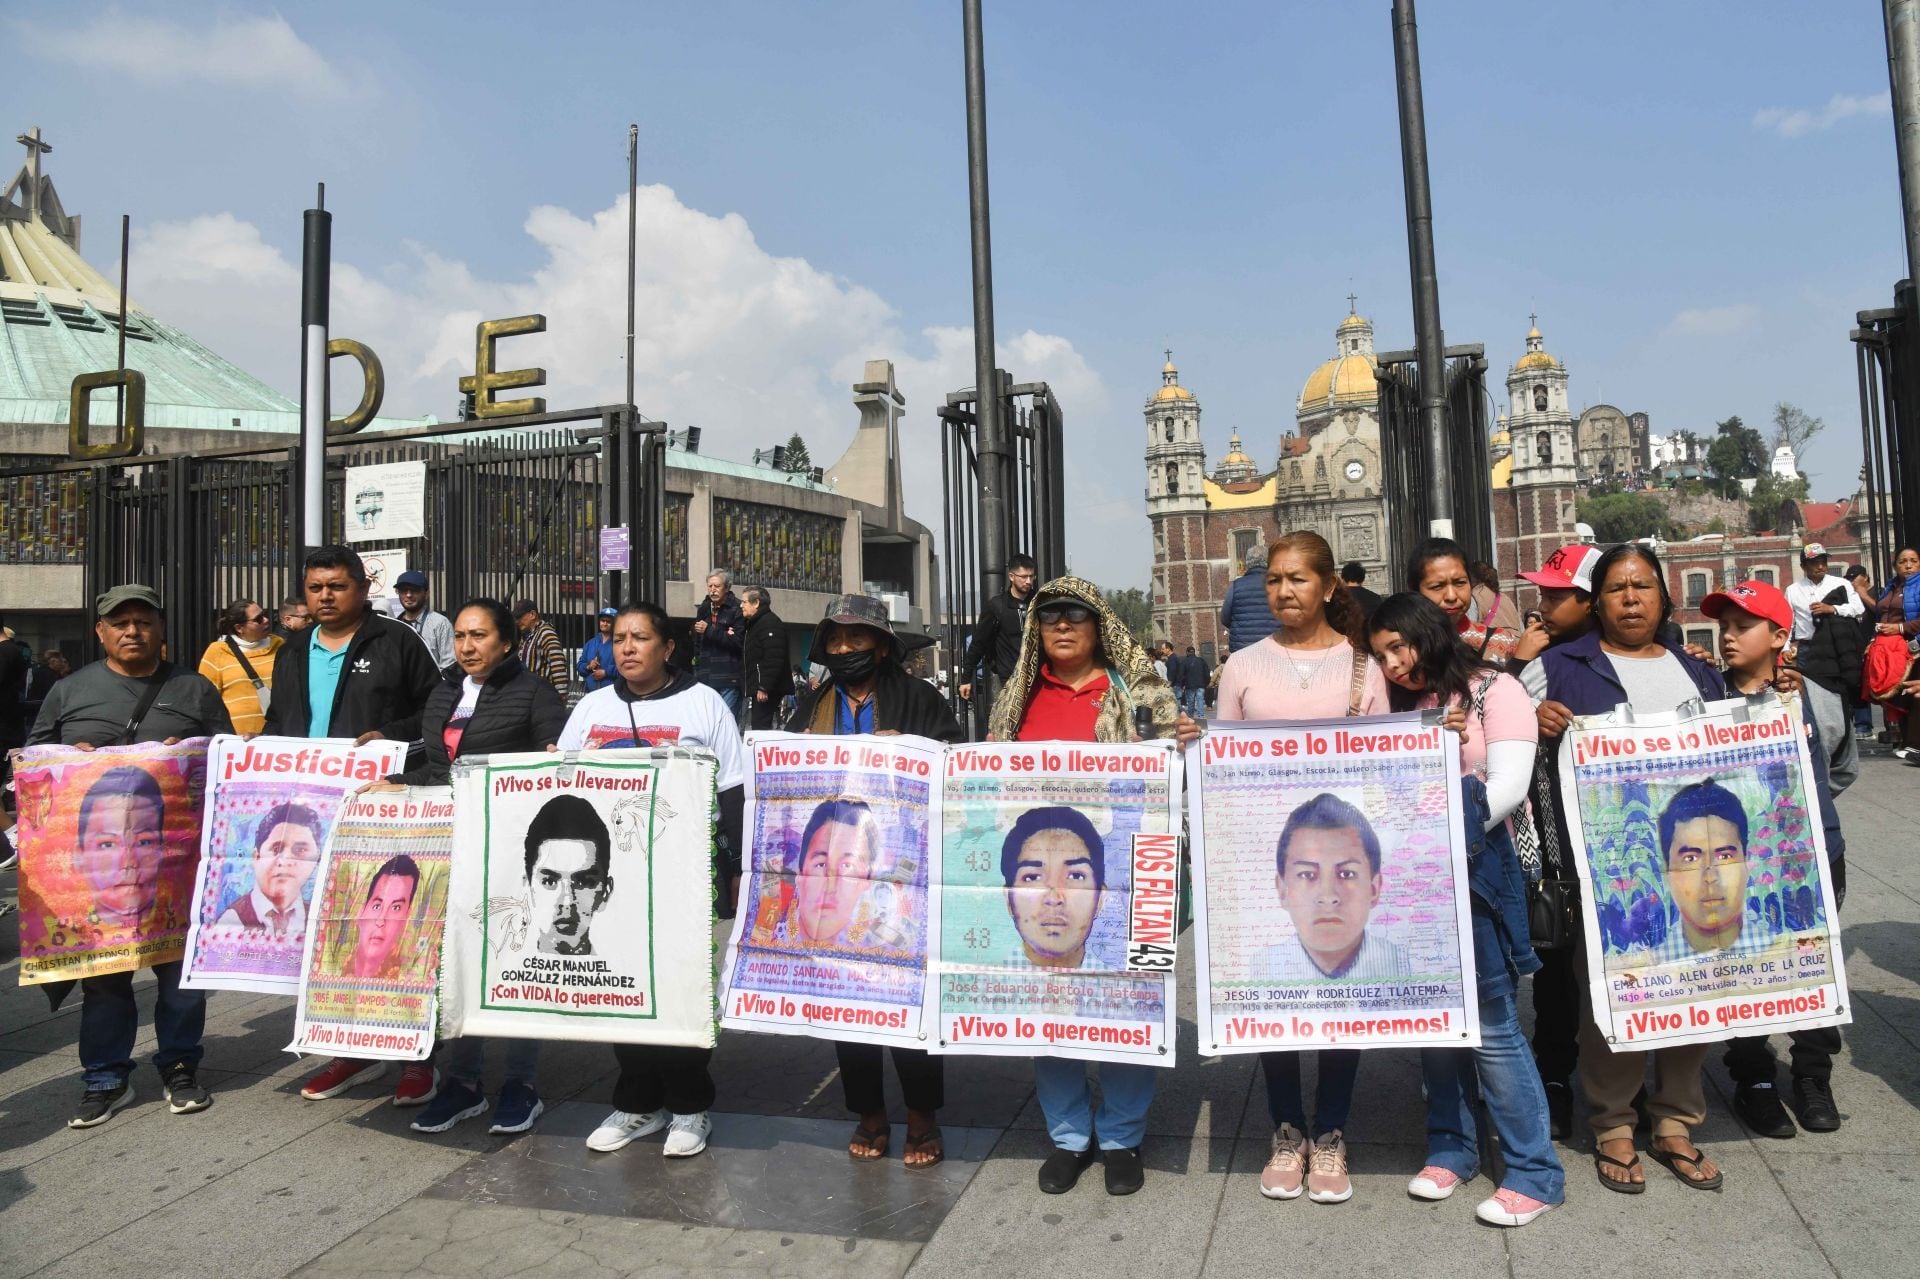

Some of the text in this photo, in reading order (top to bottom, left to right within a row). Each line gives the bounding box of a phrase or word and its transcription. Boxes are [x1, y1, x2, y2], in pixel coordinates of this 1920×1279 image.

[1204, 728, 1440, 764] ¡Vivo se lo llevaron!
[1577, 714, 1791, 764] ¡Vivo se lo llevaron!
[225, 746, 391, 781] ¡Justicia!
[757, 746, 930, 777] ¡Vivo se lo llevaro
[948, 750, 1166, 776] ¡Vivo se lo llevaron!
[1344, 766, 1370, 774] quiero
[1373, 764, 1394, 772] saber
[495, 776, 534, 796] ¡Vivo
[536, 777, 552, 791] se
[575, 770, 649, 791] llevaron!
[380, 803, 398, 818] se
[403, 799, 417, 818] lo
[964, 850, 992, 872] 43
[1135, 834, 1176, 872] NOS
[1133, 877, 1174, 944] FALTAN
[963, 927, 991, 949] 43
[25, 956, 81, 972] CHRISTIAN
[523, 956, 612, 973] CÉSAR MANUEL
[748, 962, 789, 977] ANTONIO
[792, 966, 840, 981] SANTANA
[1614, 954, 1826, 991] EMILIANO ALEN GASPAR DE LA CRUZ
[502, 970, 636, 988] GONZÁLEZ HERNÁNDEZ
[948, 982, 1159, 1000] José Eduardo Bartolo Tlatempa
[1618, 994, 1639, 1003] Hijo
[1644, 991, 1655, 999] de
[1658, 988, 1684, 998] Celso
[1688, 986, 1694, 995] y
[1768, 976, 1787, 984] años
[491, 984, 644, 1008] ¡Con VIDA lo queremos!
[1224, 985, 1448, 1001] JESÚS JOVANY RODRÍGUEZ TLATEMPA
[735, 992, 908, 1028] ¡Vivo lo queremos!
[1626, 988, 1826, 1040] ¡Vivo lo queremos!
[304, 1024, 420, 1051] ¡Vivo lo queremos!
[952, 1016, 1151, 1046] ¡Vivo lo queremos!
[1225, 1012, 1450, 1044] ¡Vivo lo queremos!
